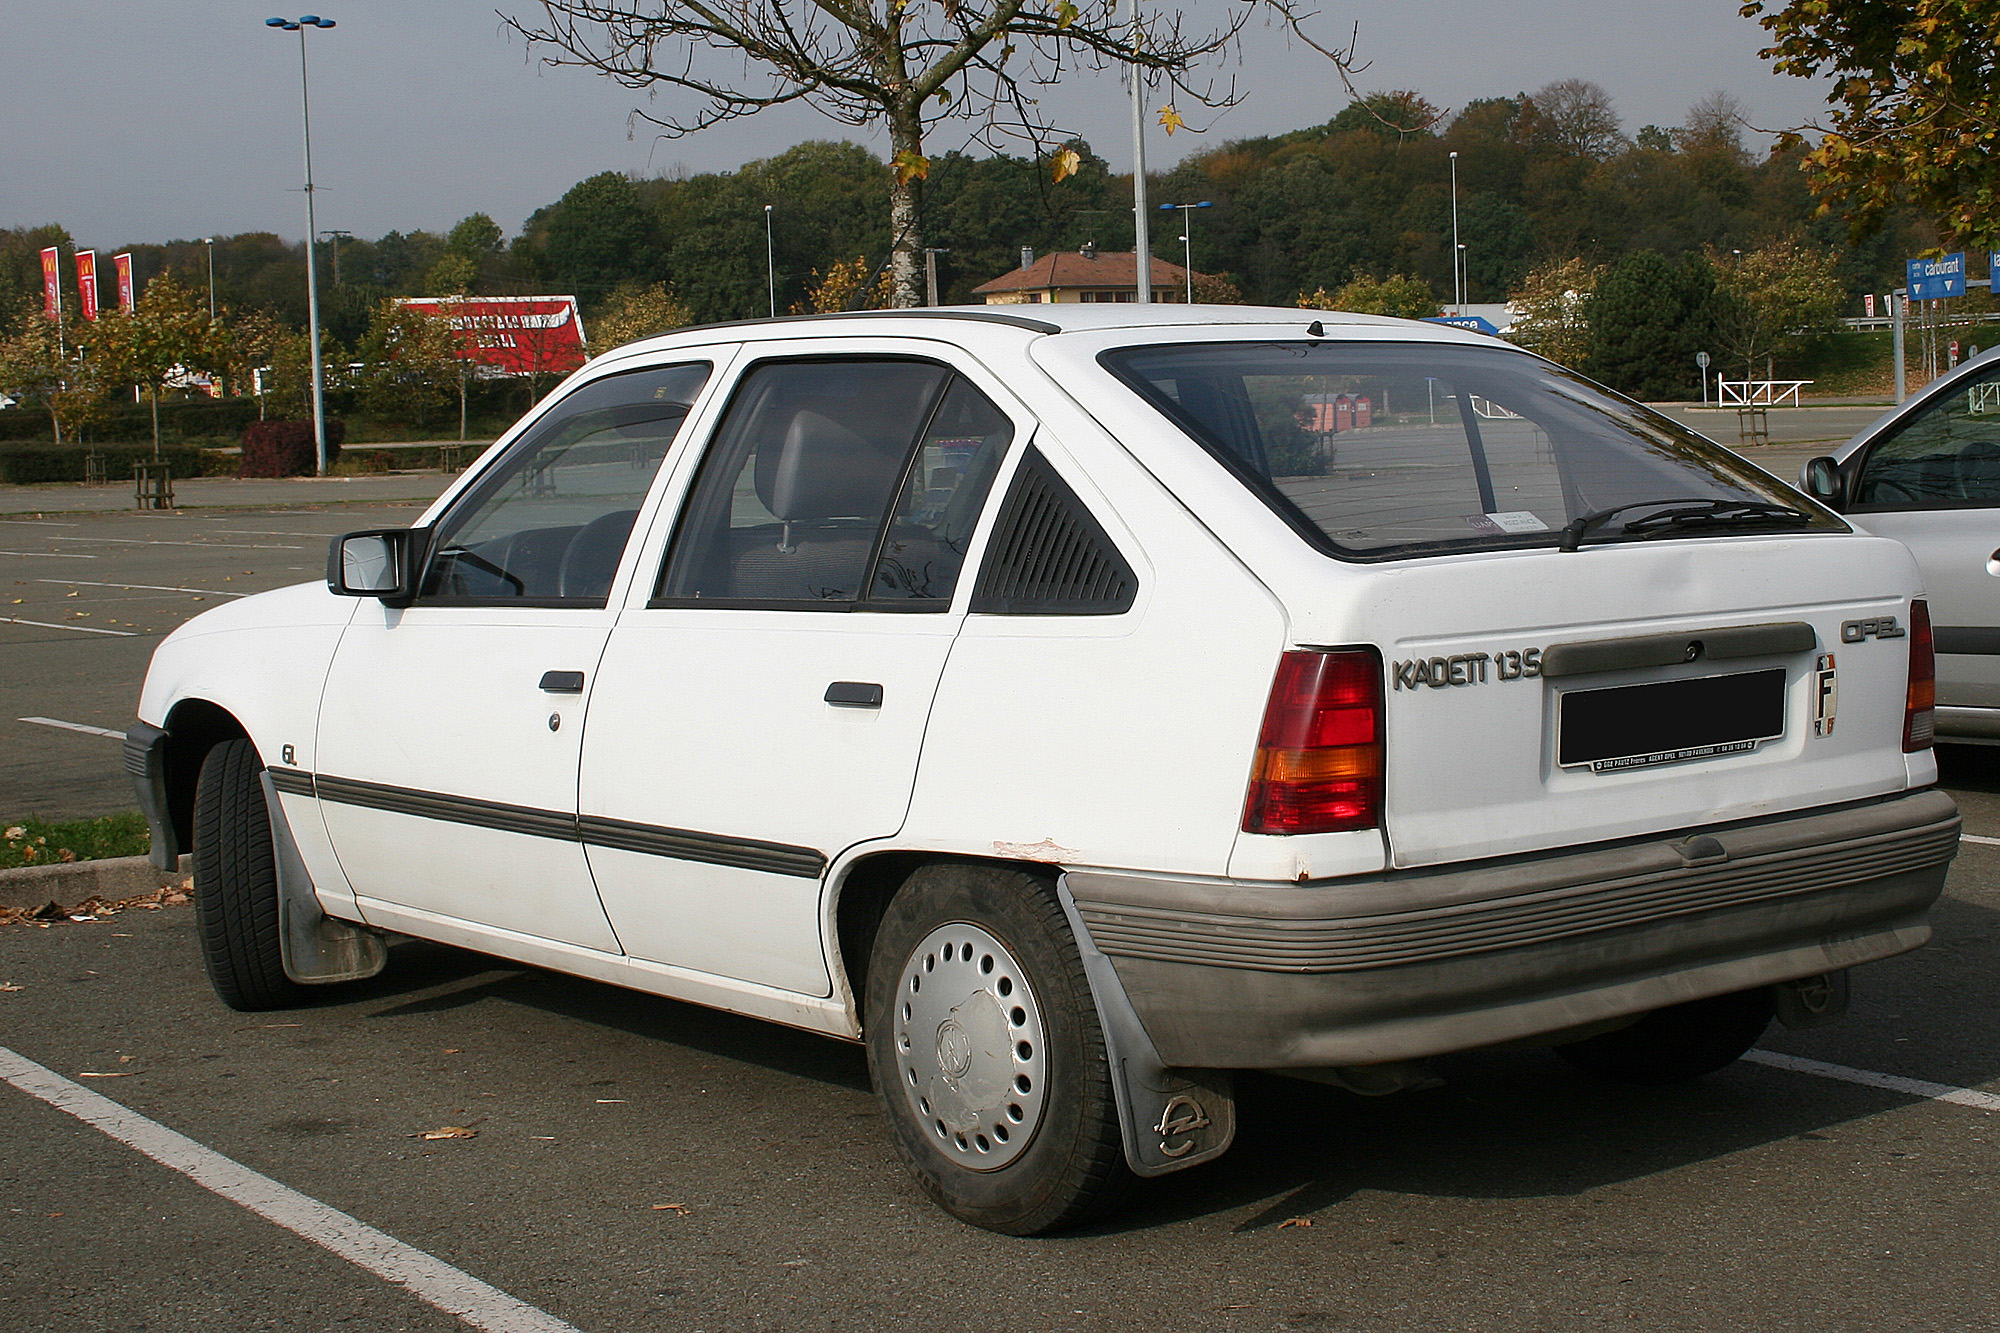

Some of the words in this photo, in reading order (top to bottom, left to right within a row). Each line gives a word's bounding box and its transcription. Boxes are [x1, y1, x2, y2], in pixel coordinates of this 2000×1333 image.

[1841, 616, 1905, 644] OPEL
[1392, 652, 1489, 690] KADETT
[1818, 670, 1835, 719] F
